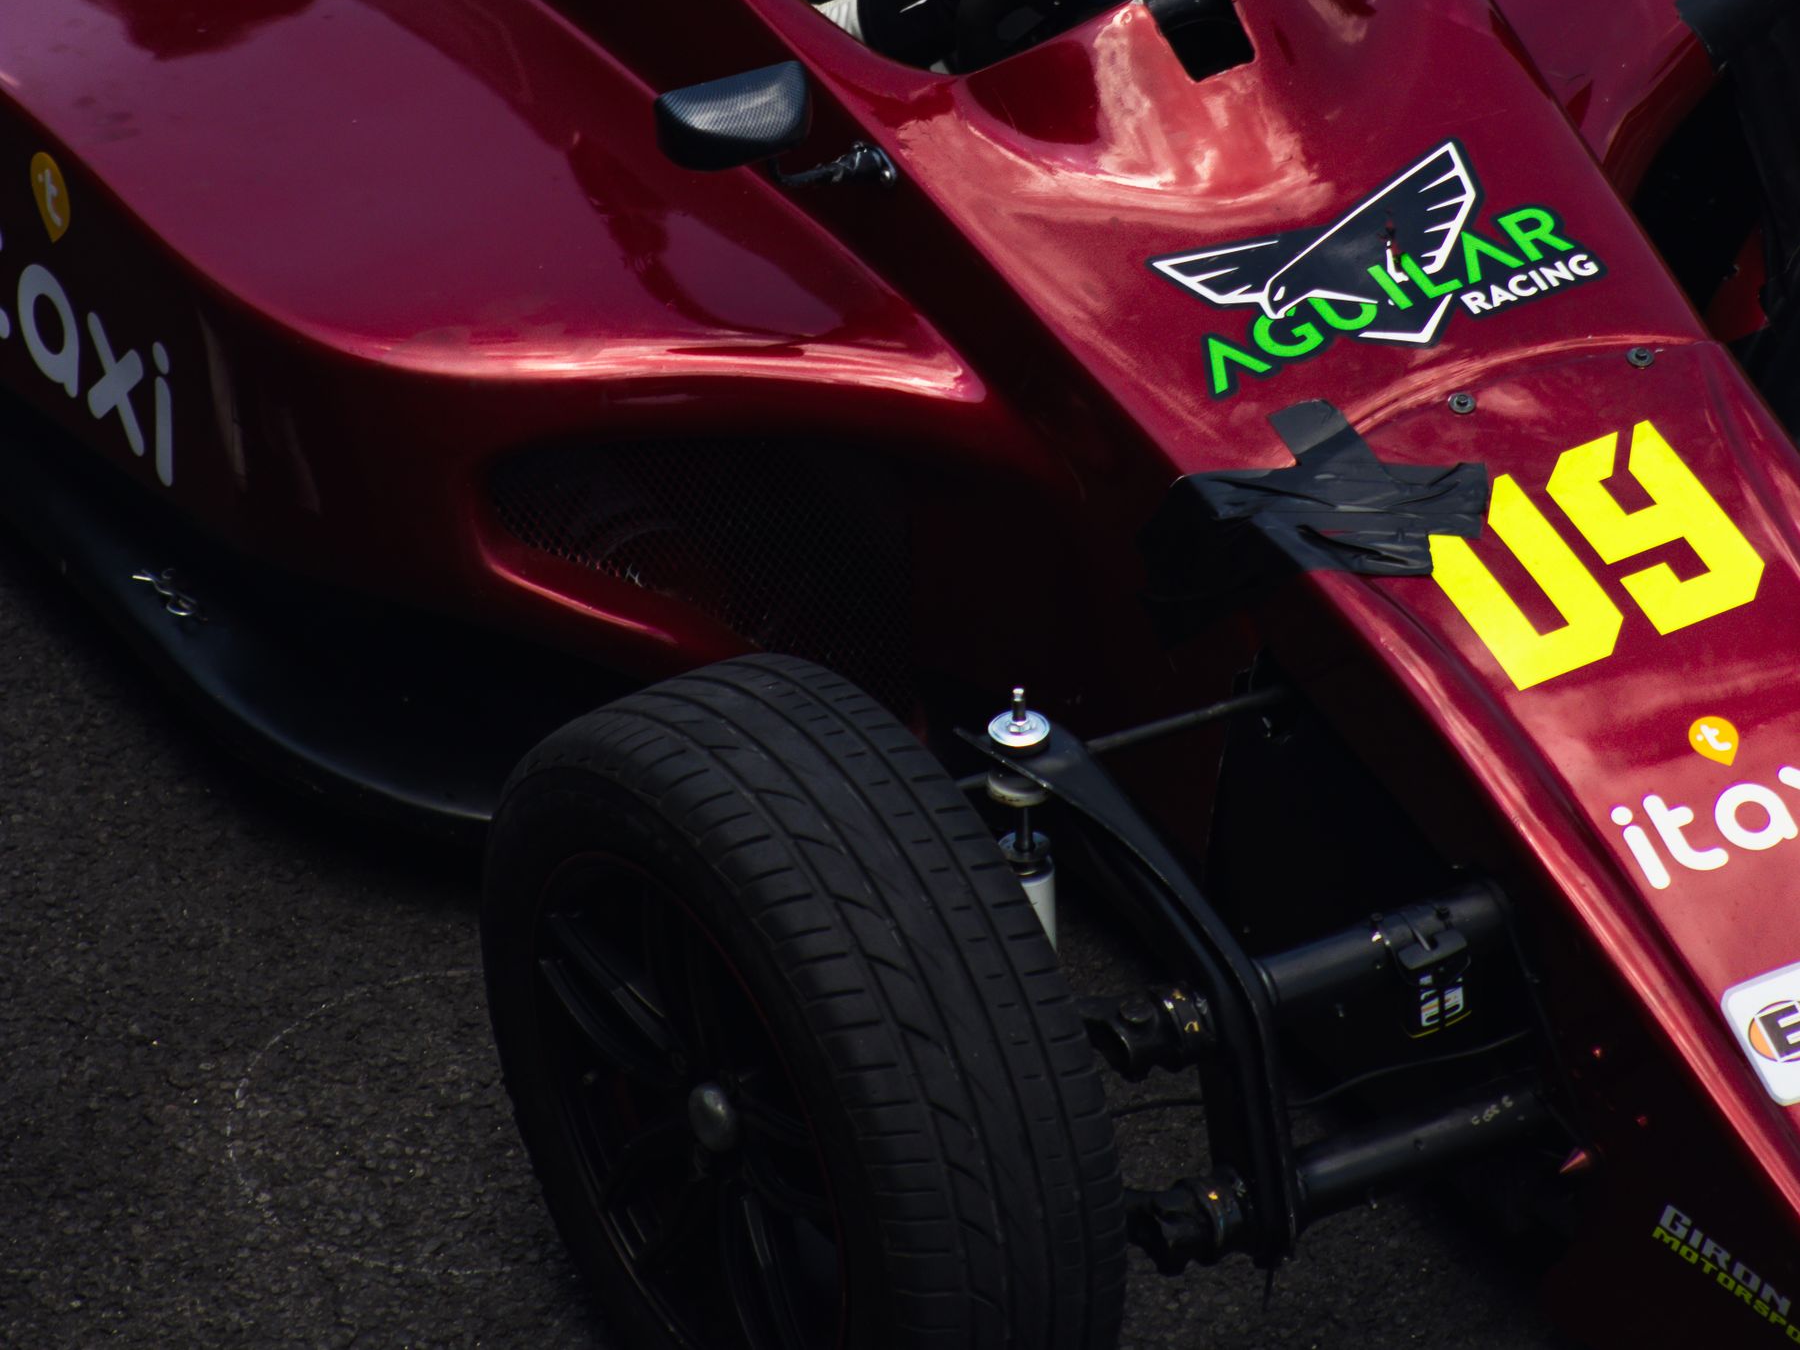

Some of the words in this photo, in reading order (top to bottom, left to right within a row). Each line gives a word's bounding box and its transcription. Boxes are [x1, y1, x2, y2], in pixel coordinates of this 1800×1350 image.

[0, 228, 174, 488] axi
[1206, 207, 1576, 394] AGUILAR
[1460, 254, 1599, 315] RACING
[1659, 1204, 1792, 1317] GIRON
